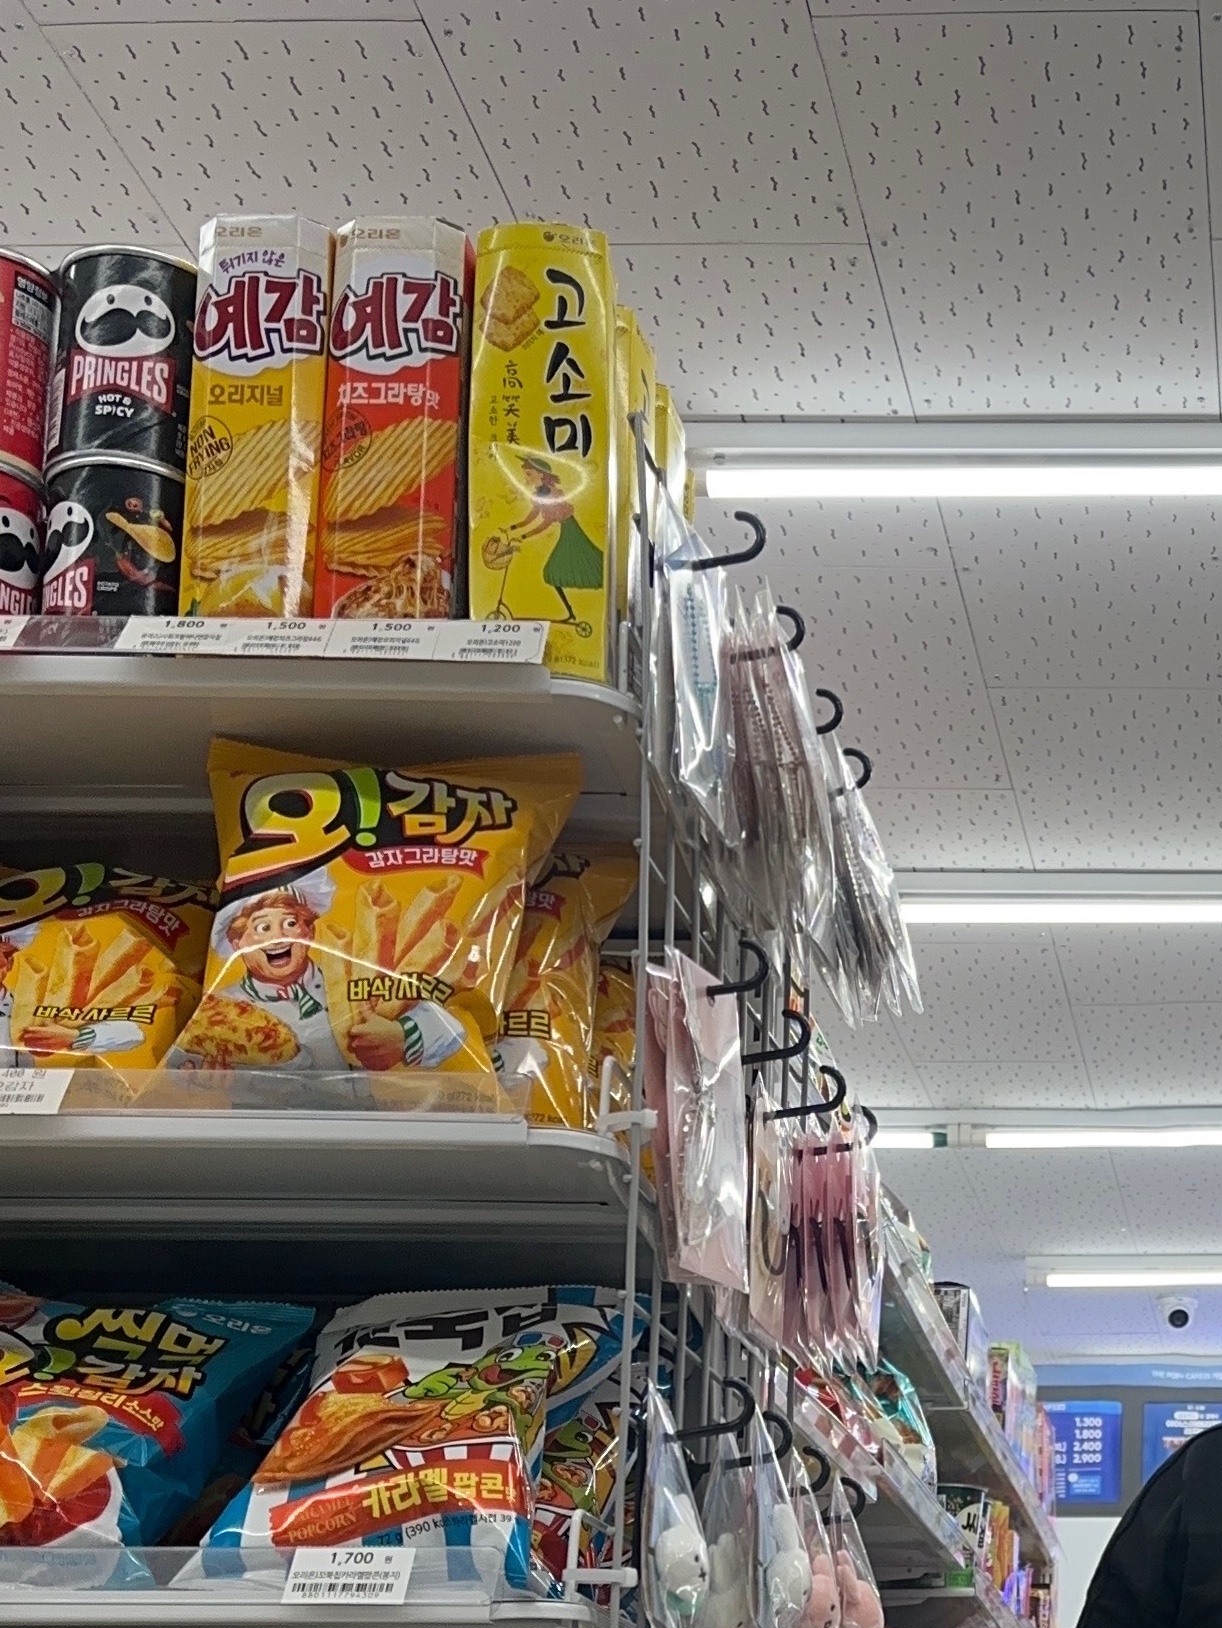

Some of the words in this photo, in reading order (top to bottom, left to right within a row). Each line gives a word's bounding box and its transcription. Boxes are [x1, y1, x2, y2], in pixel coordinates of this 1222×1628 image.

[194, 269, 326, 360] 예감
[330, 271, 462, 359] 예감
[542, 268, 594, 458] 고소미
[69, 354, 170, 405] PRINGLES
[98, 393, 121, 405] HOT
[207, 384, 284, 408] 오리지널
[336, 382, 441, 411] 치즈그라탕맛
[94, 404, 135, 418] SPICY
[189, 423, 217, 459] NON
[187, 435, 232, 476] FRYING
[165, 620, 205, 629] 1,800
[266, 621, 307, 631] 1,500
[371, 622, 412, 632] 1,500
[481, 624, 521, 634] 1,200
[222, 767, 516, 884] 오!감자
[364, 846, 480, 869] 감자그라탕맛
[349, 977, 393, 1001] 바삭
[36, 1005, 82, 1021] 바삭
[83, 1004, 157, 1024] 사르르
[362, 1467, 448, 1519] 카라멜
[287, 1511, 357, 1544] POPCORN
[405, 1520, 431, 1541] (390
[330, 1552, 374, 1566] 1,700
